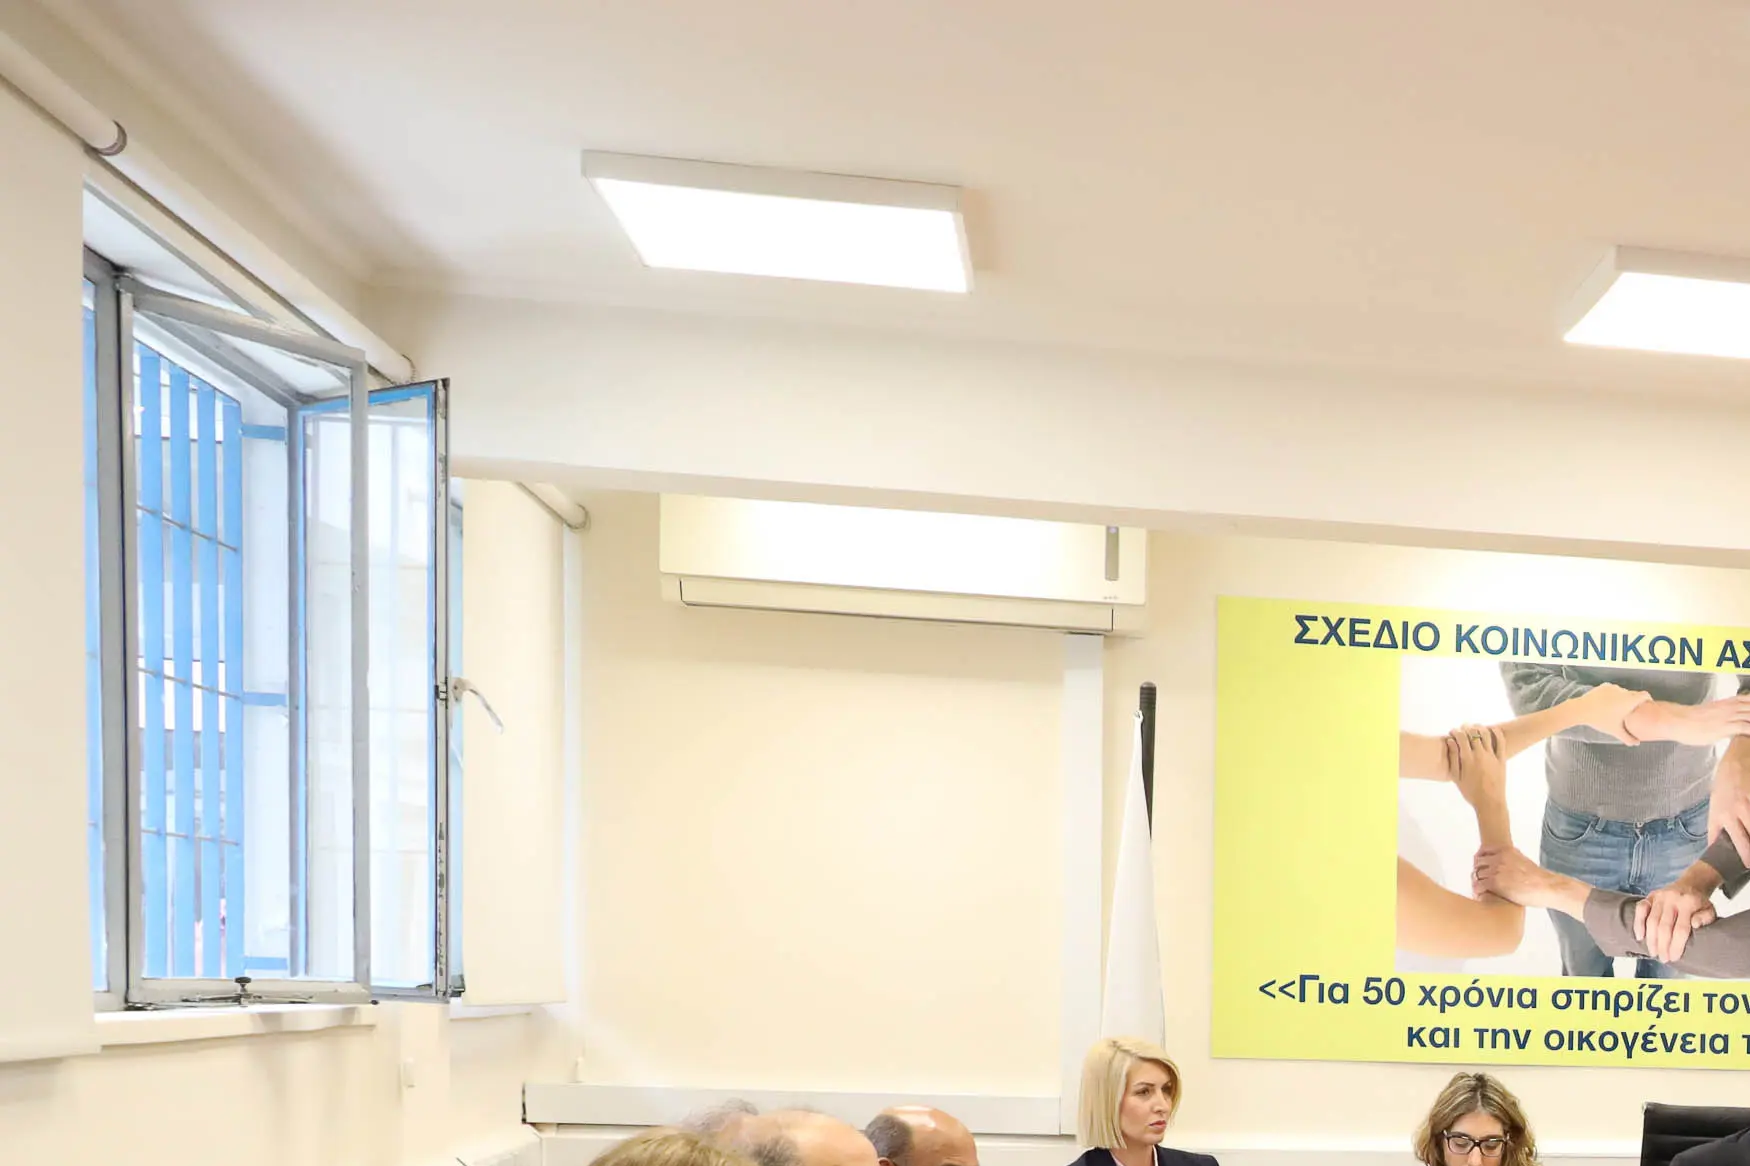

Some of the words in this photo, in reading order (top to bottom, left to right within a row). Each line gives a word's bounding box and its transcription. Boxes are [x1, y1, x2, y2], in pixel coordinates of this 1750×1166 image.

[1294, 615, 1441, 652] ΣΧΕΔΙΟ
[1455, 623, 1703, 666] ΚΟΙΝΩΝΙΚΩΝ
[1362, 976, 1406, 1006] 50
[1417, 979, 1538, 1014] χρόνια
[1551, 983, 1690, 1019] στηρίζει
[1407, 1026, 1460, 1049] και
[1473, 1027, 1532, 1050] την
[1543, 1024, 1729, 1059] οικογένεια
